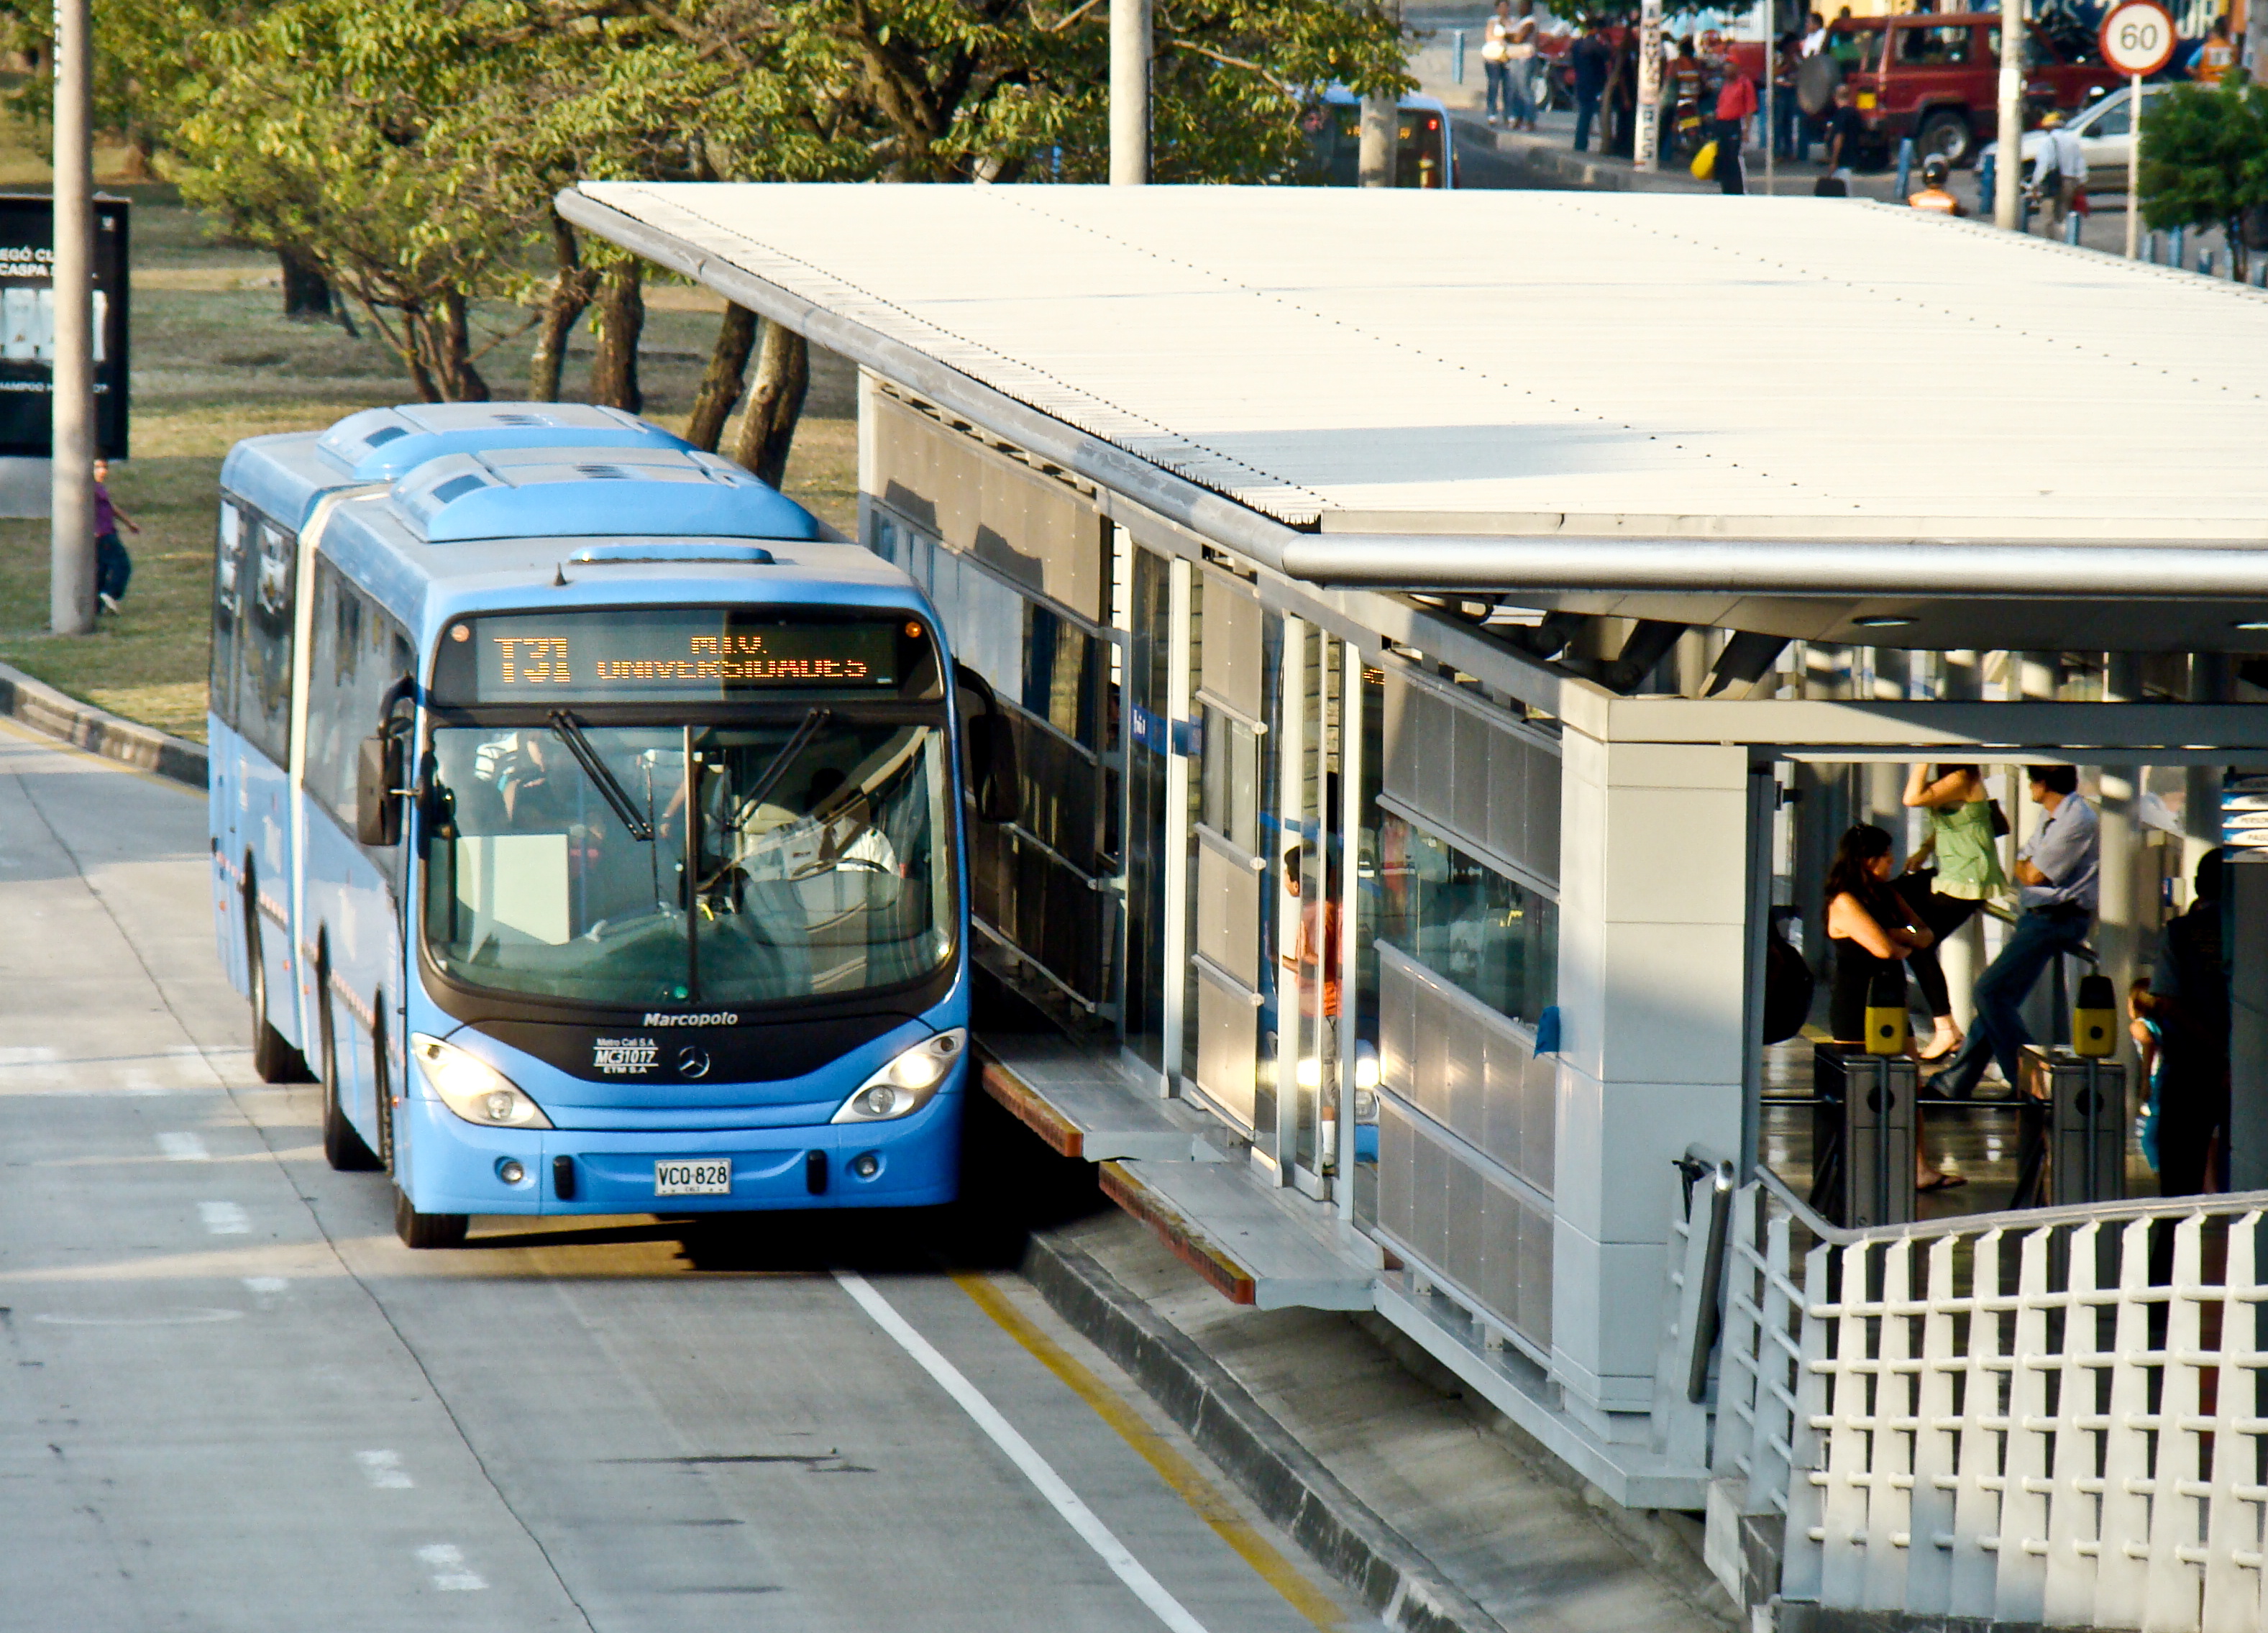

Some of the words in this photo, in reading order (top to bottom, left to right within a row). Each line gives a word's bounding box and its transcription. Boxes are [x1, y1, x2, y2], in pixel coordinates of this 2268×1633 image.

[2120, 22, 2157, 50] 60
[493, 637, 571, 683] T31
[597, 659, 867, 680] UNIVERSIDADES
[644, 1011, 739, 1027] Marcopolo
[594, 1049, 656, 1063] MC31017
[603, 1066, 627, 1074] ETM
